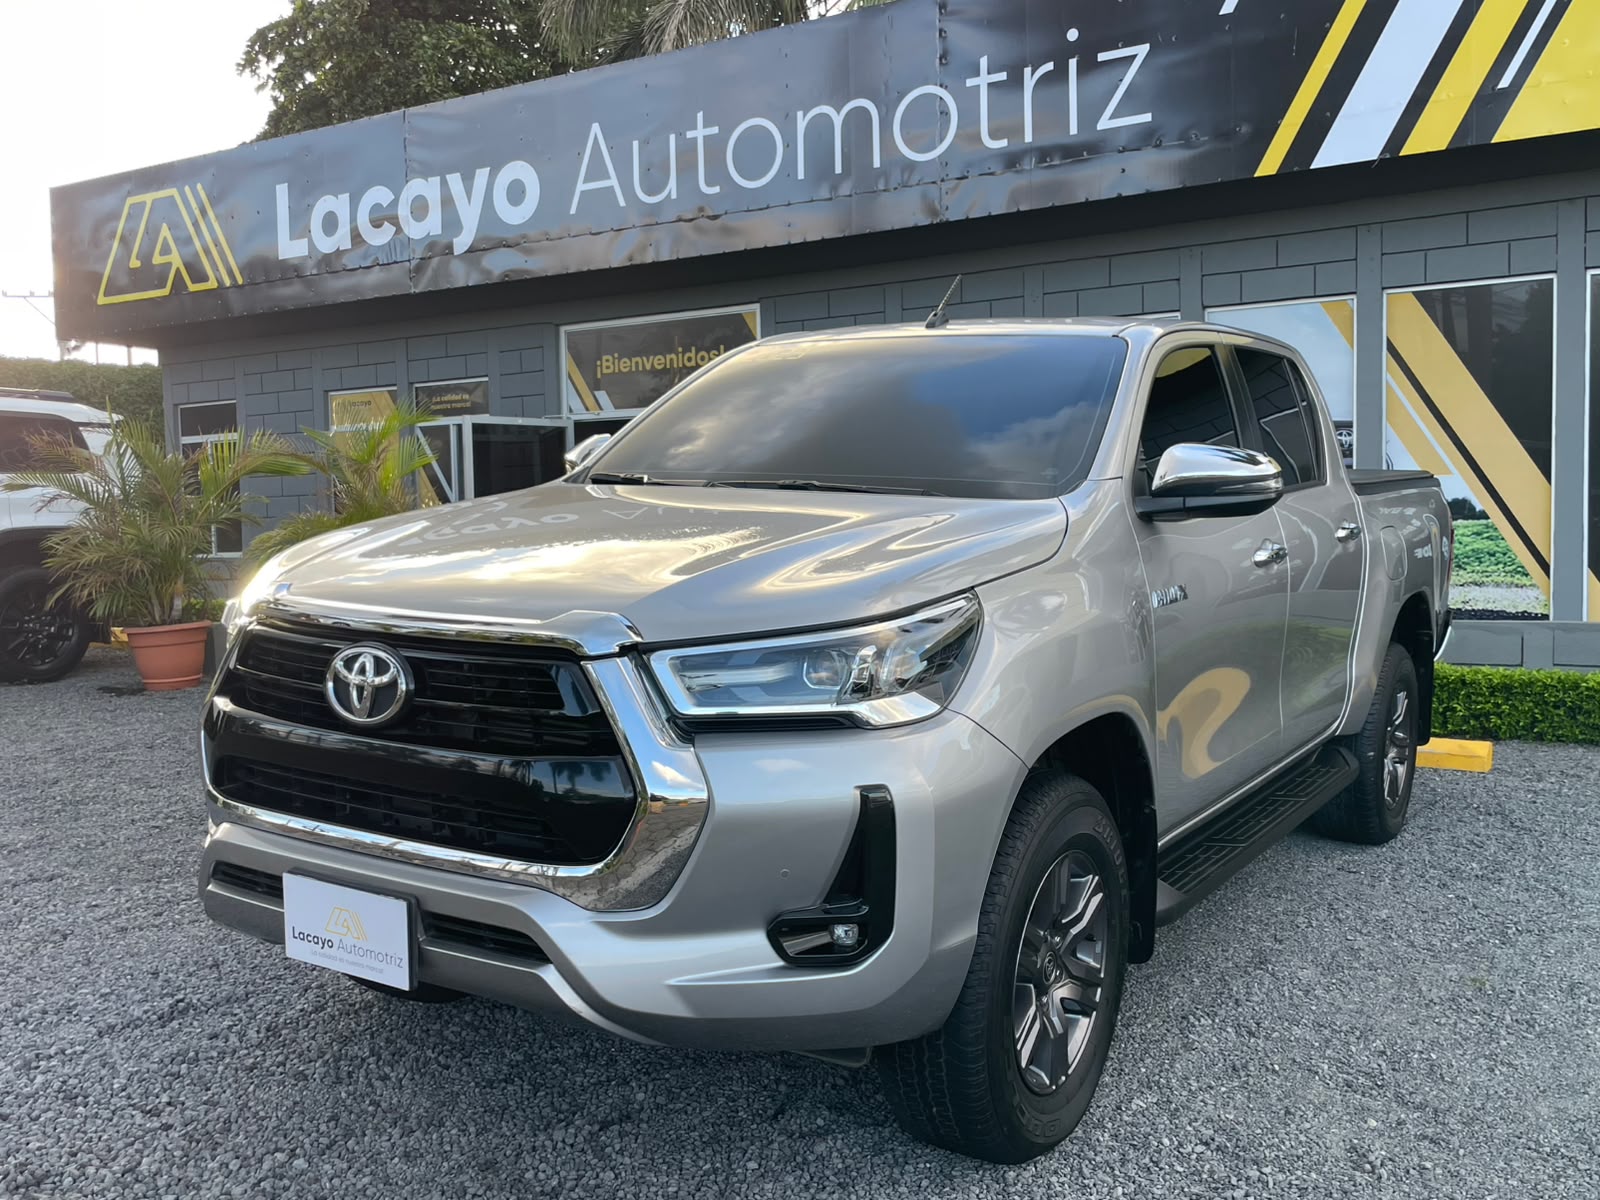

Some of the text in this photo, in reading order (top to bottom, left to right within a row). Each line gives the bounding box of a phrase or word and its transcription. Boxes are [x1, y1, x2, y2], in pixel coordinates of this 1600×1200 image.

[275, 28, 1152, 261] Lacayo Automotriz
[292, 926, 404, 969] Lacayo Automotriz
